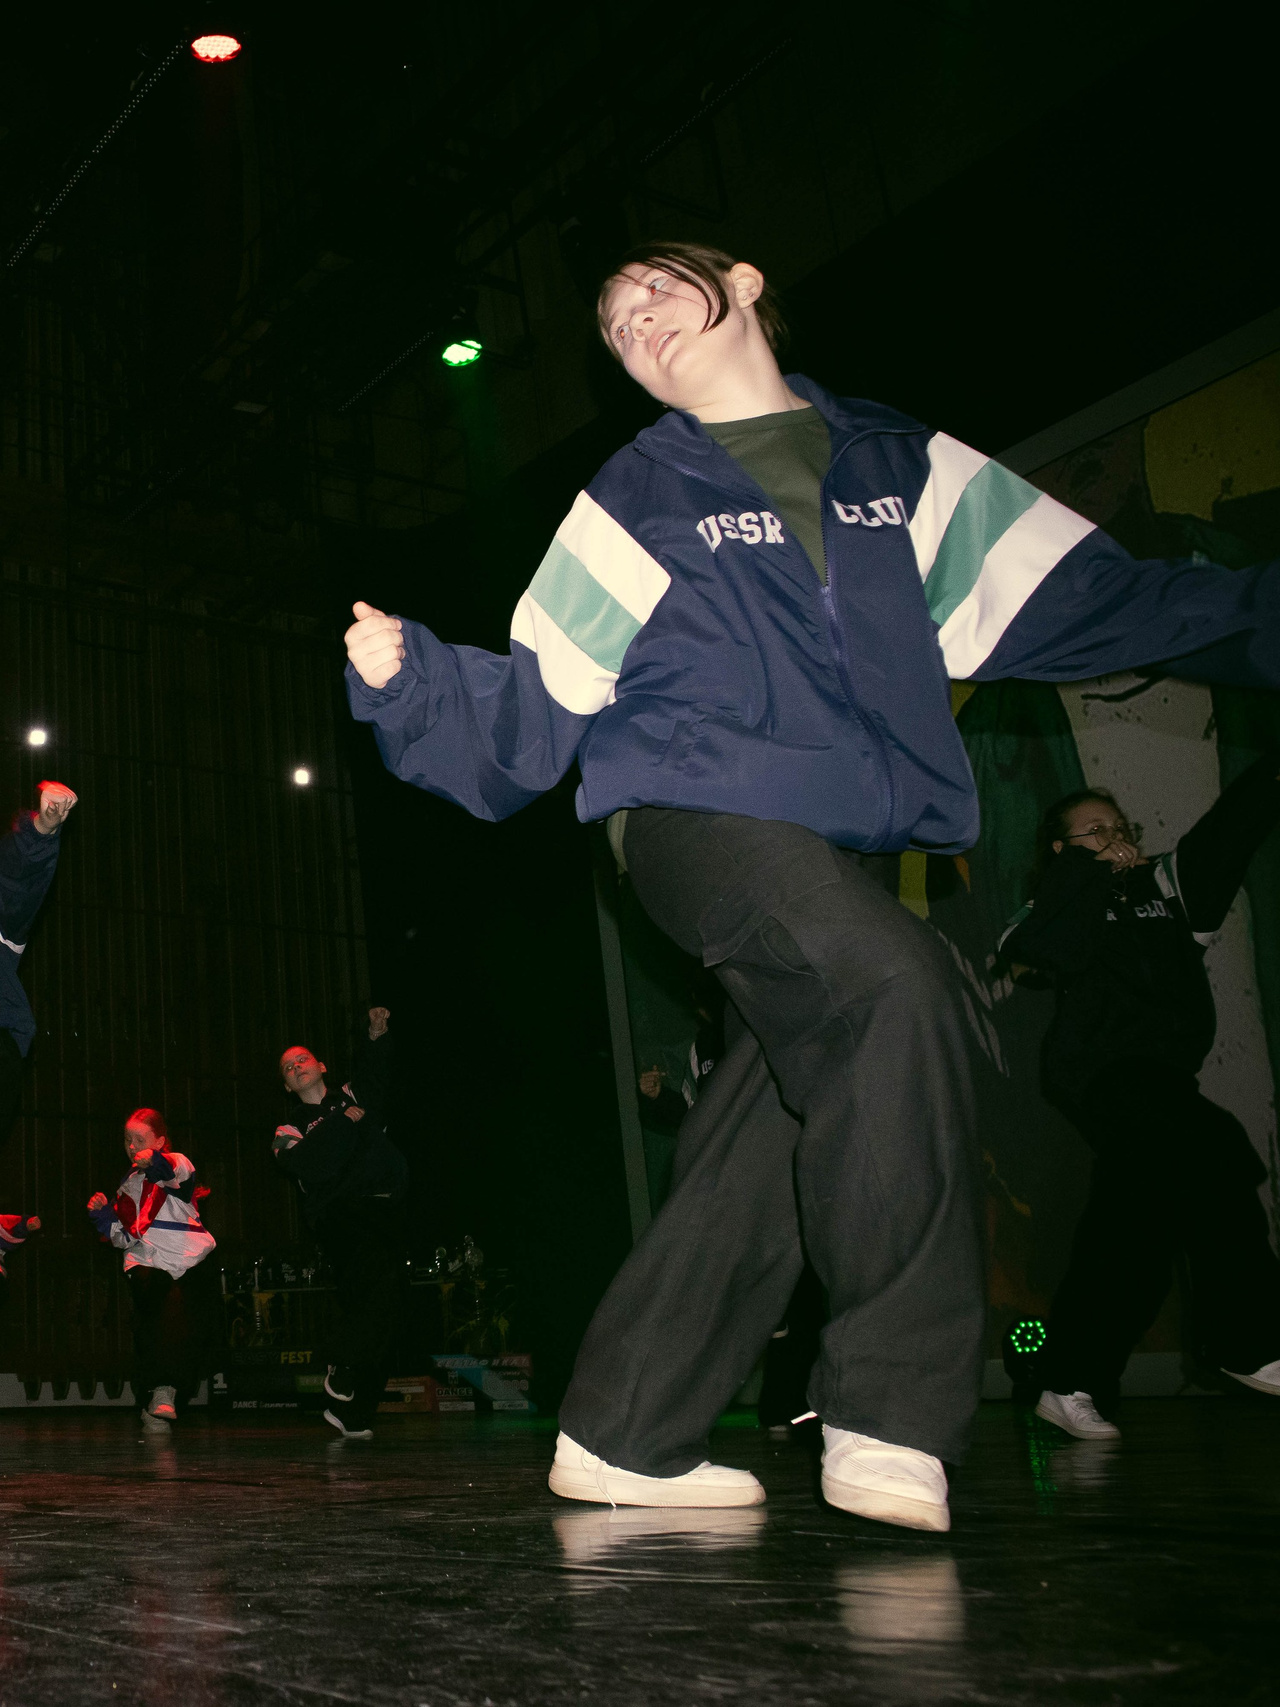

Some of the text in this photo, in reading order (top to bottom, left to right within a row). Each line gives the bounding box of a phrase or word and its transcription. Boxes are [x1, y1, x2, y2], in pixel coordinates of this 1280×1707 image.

[696, 510, 785, 553] USSR
[1133, 899, 1174, 919] CLU
[280, 1350, 313, 1364] FEST
[232, 1400, 258, 1409] DANCE
